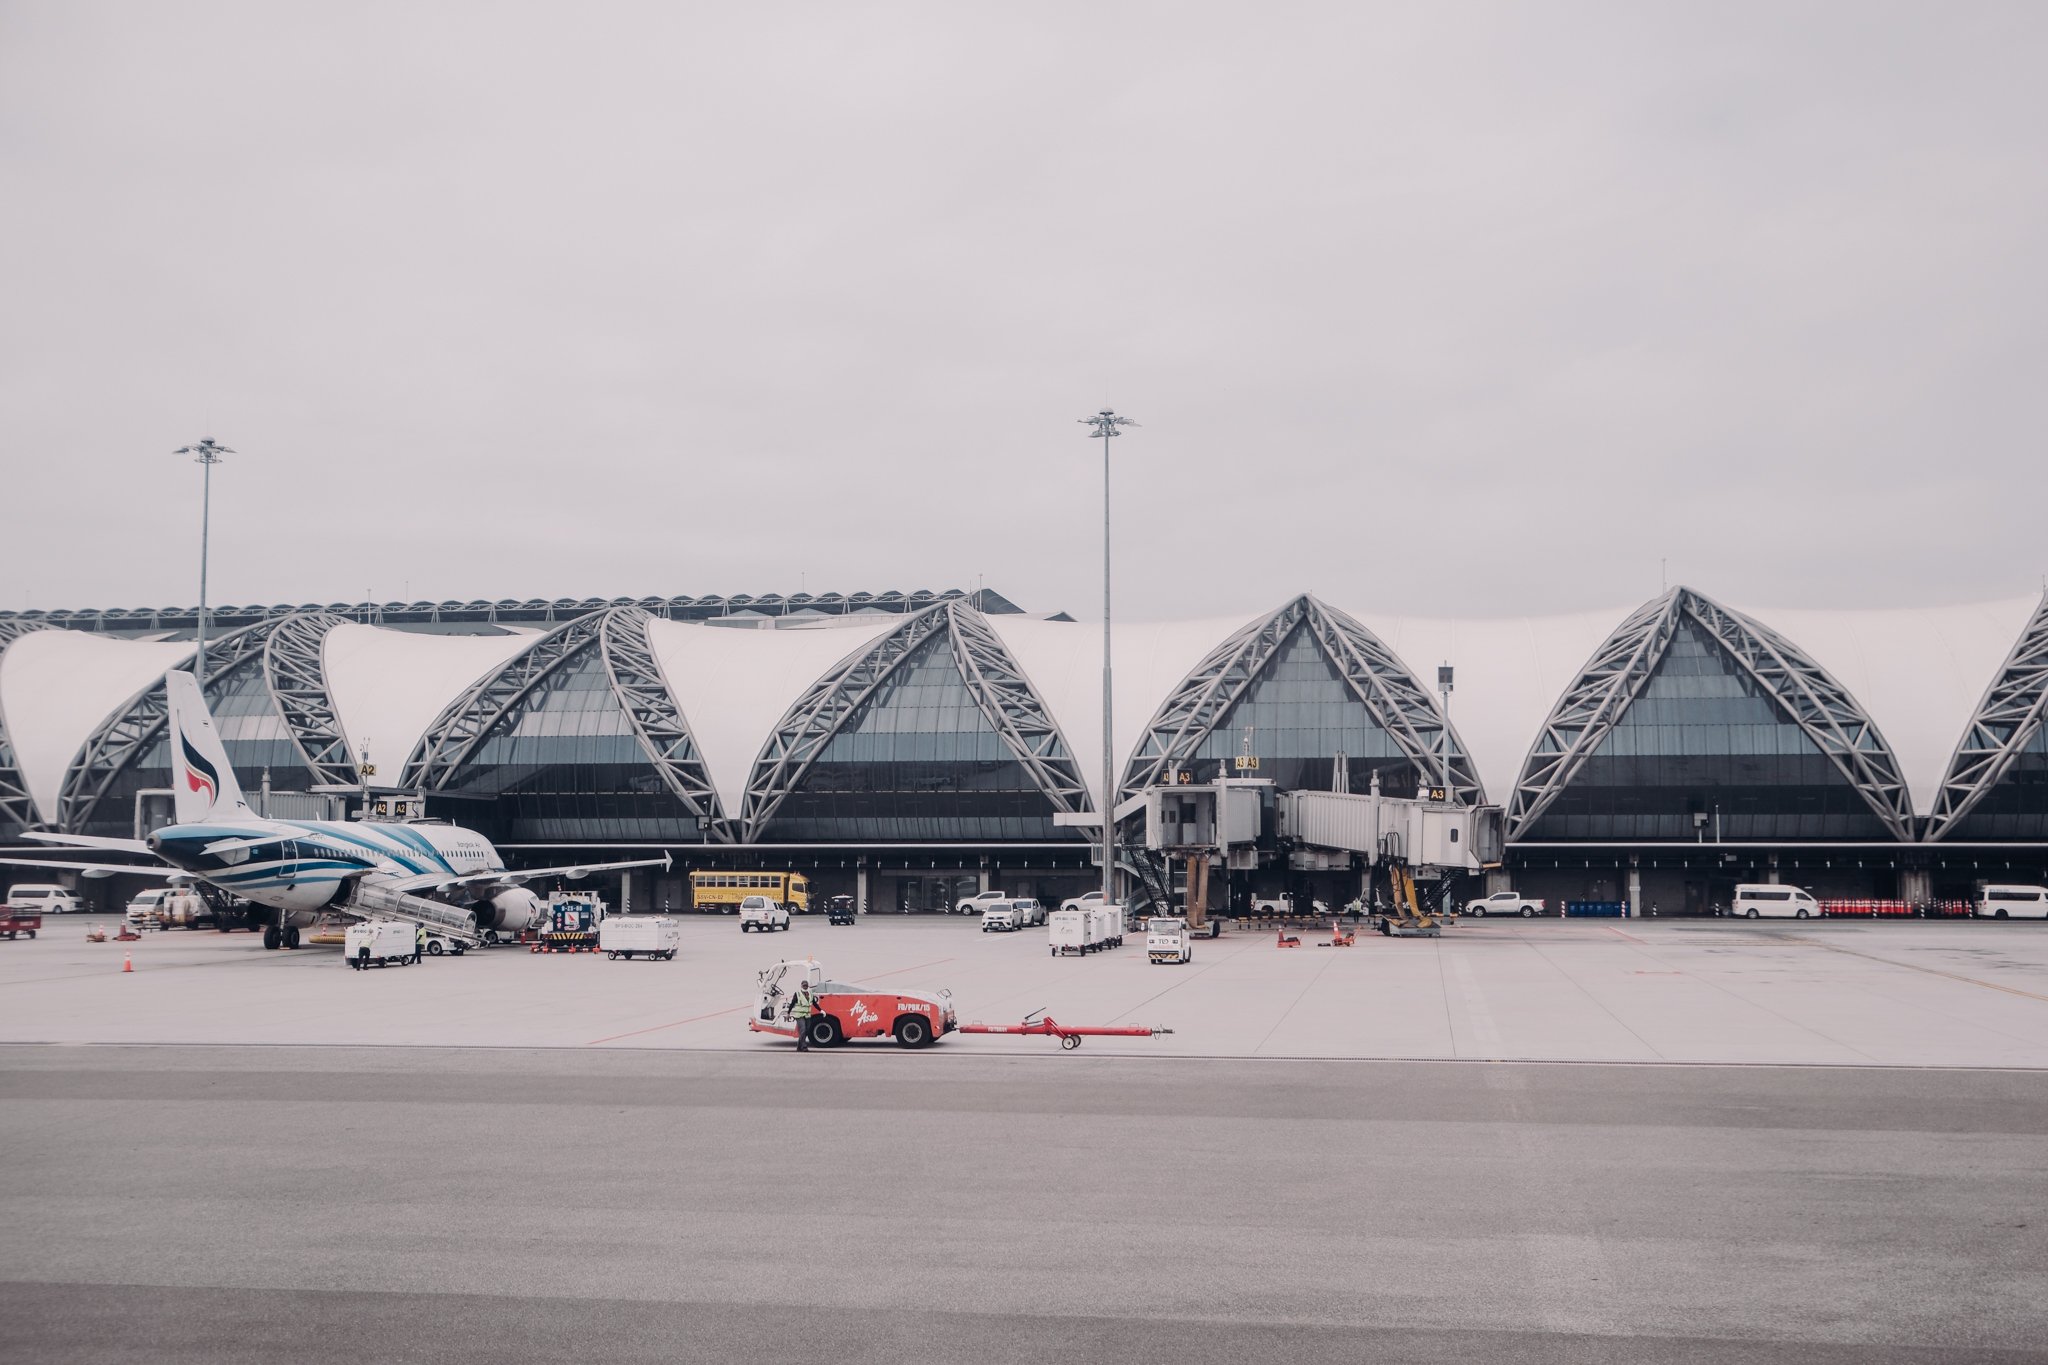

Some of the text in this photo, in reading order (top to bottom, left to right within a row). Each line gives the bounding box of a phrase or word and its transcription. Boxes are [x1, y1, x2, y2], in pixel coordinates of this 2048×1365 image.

[1236, 757, 1245, 768] A3
[1246, 757, 1258, 768] A3
[361, 765, 375, 775] A2
[1179, 773, 1191, 782] A3
[1431, 789, 1445, 799] A3
[377, 803, 387, 813] A2
[396, 804, 406, 813] A2
[850, 999, 867, 1016] Air
[857, 1009, 879, 1026] Asia
